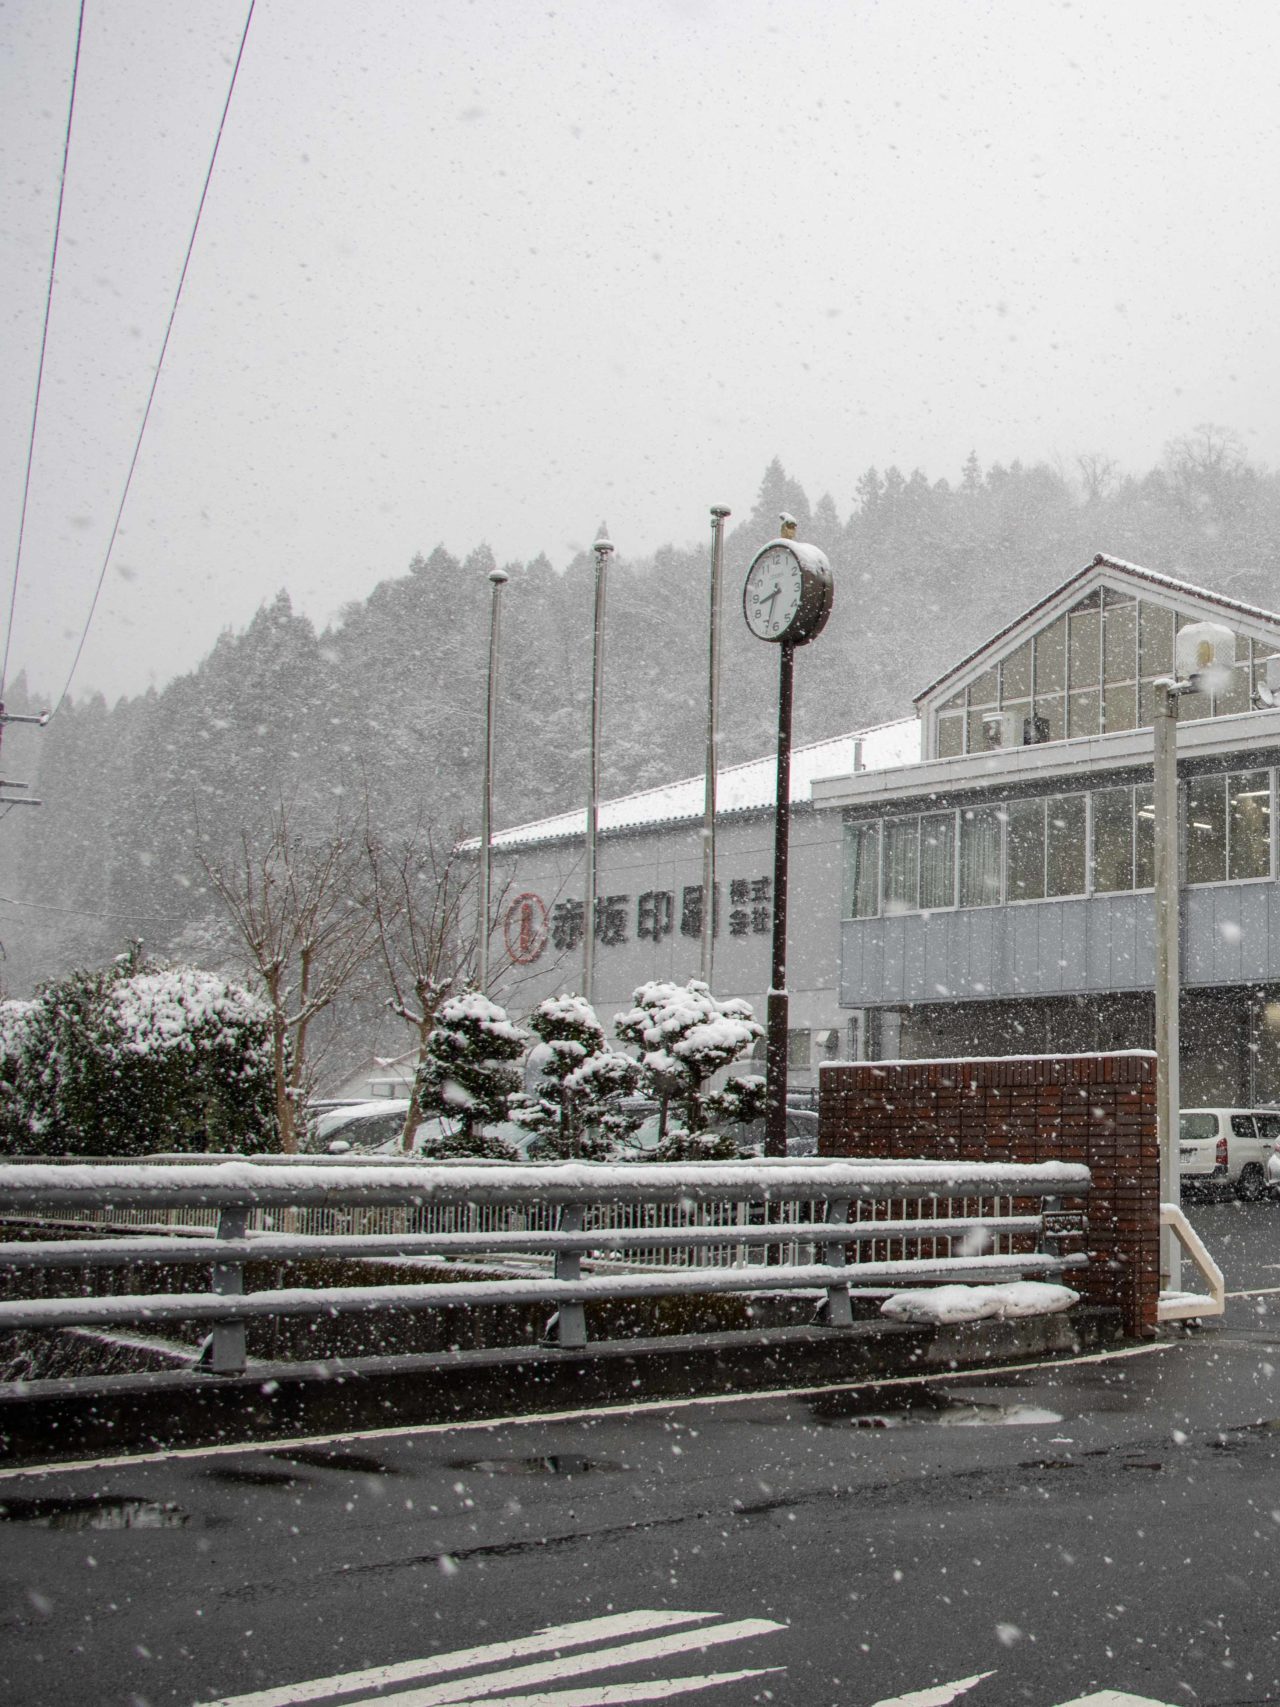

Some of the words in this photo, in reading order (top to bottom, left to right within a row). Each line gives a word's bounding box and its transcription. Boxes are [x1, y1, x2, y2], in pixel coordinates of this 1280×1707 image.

[772, 555, 781, 565] 12
[762, 564, 770, 575] 11
[791, 567, 798, 577] 2
[793, 582, 800, 592] 3
[752, 594, 760, 604] 9
[790, 598, 798, 607] 4
[754, 609, 762, 619] 8
[784, 613, 791, 622] 5
[772, 622, 780, 631] 6
